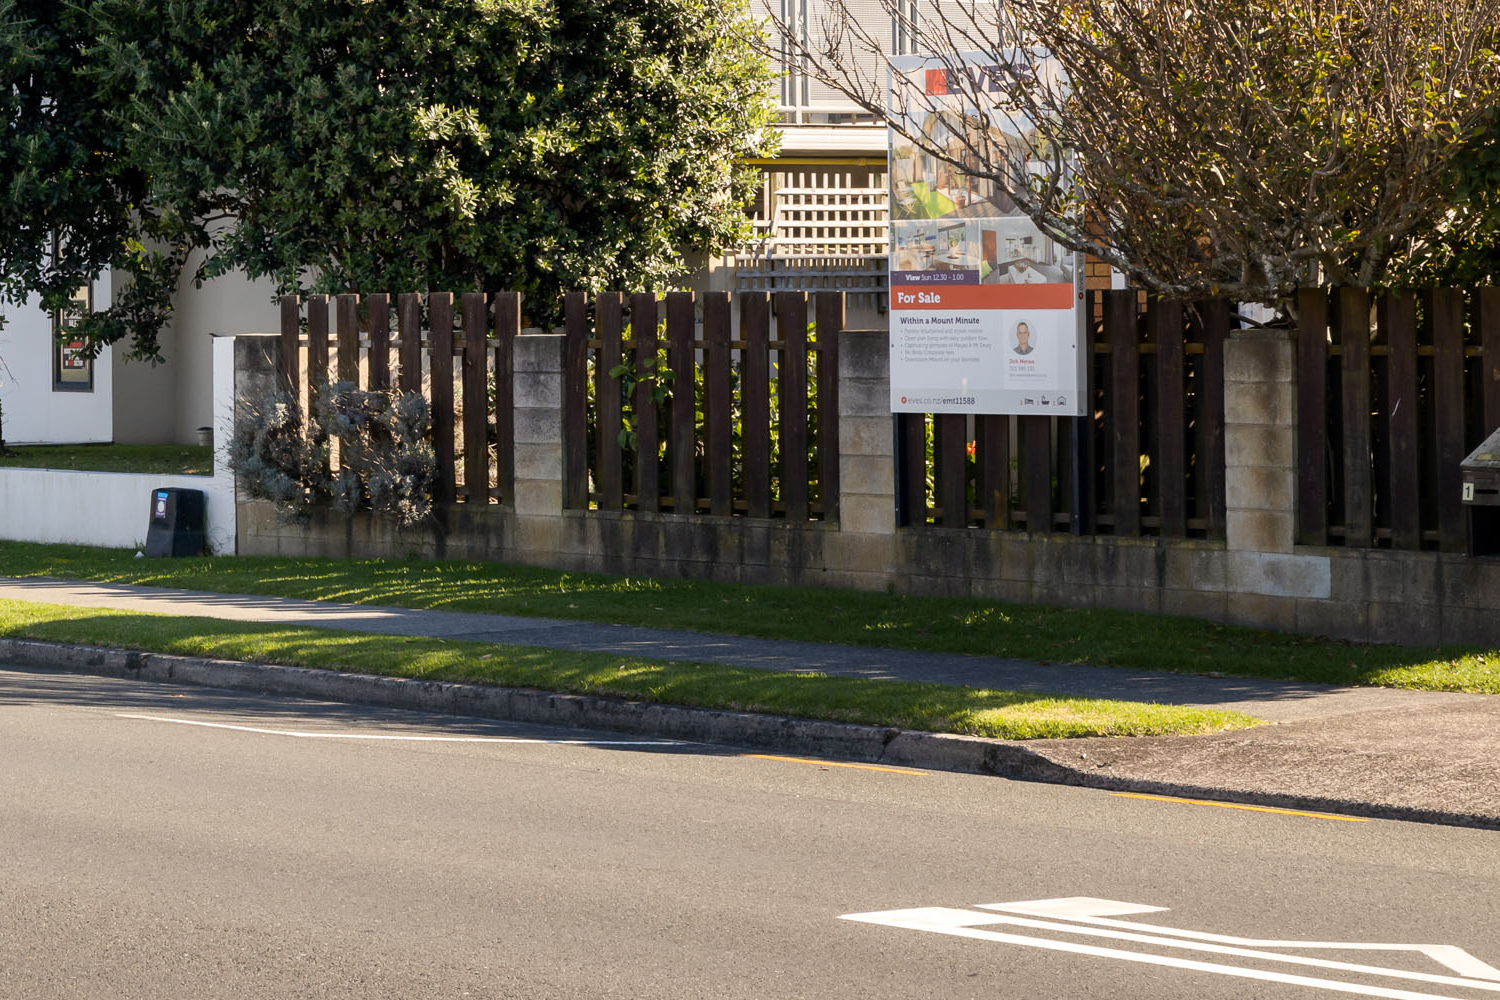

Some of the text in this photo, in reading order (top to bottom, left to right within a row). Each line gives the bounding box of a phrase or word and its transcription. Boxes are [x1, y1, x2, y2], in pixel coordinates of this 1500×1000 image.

[905, 273, 921, 281] View
[921, 273, 932, 281] Sun
[897, 291, 941, 304] For Sale
[900, 316, 924, 324] Within
[931, 316, 954, 324] Mount
[955, 316, 980, 324] Minute
[1465, 485, 1470, 498] 1
